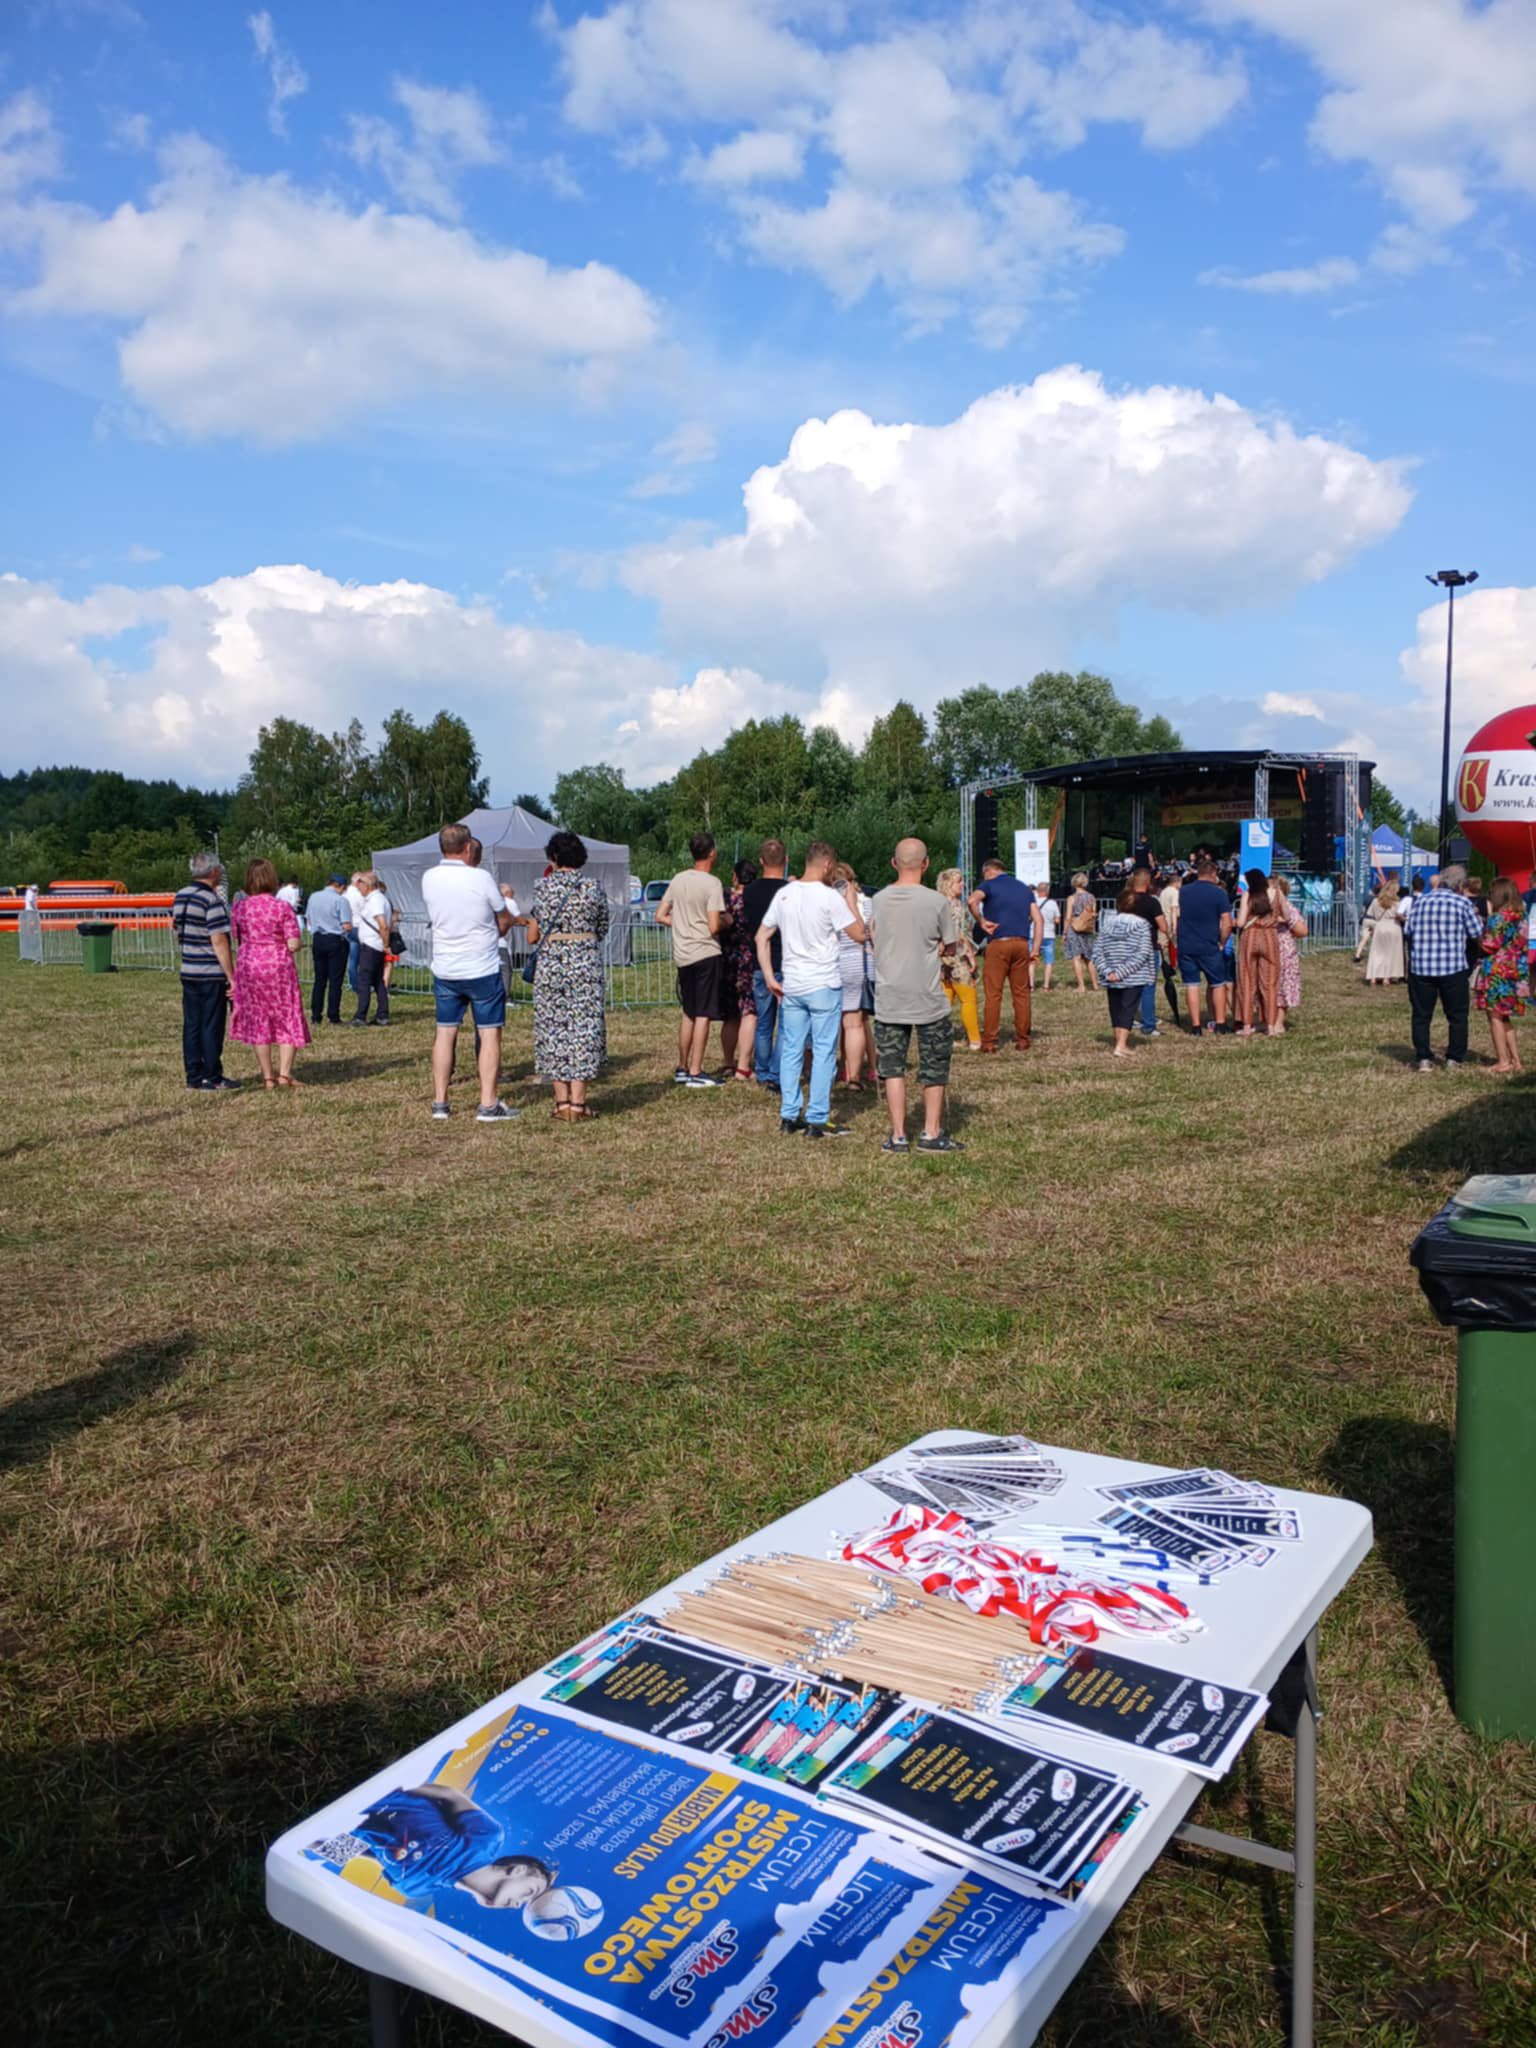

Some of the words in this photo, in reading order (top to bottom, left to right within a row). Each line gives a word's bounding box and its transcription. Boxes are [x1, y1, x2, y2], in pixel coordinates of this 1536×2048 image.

[1493, 797, 1536, 808] www.k
[685, 1688, 728, 1720] LICEUM
[1164, 1699, 1198, 1730] LICEUM
[582, 1761, 658, 1816] lekkoatletyka
[633, 1768, 676, 1798] boccia
[656, 1774, 697, 1801] bilard
[598, 1799, 640, 1828] sztuki
[624, 1802, 664, 1828] piłka
[666, 1784, 725, 1830] NABÓR
[1000, 1786, 1045, 1826] LICEUM
[538, 1817, 589, 1852] szachy
[572, 1824, 610, 1851] walki
[598, 1824, 638, 1854] nożna
[645, 1823, 682, 1847] DO
[610, 1841, 663, 1880] KLAS
[747, 1819, 829, 1892] LICEUM
[576, 1799, 775, 1979] SPORTOWEGO
[607, 1808, 802, 1992] MISTRZOSTWA
[795, 1870, 883, 1947] LICEUM
[927, 1892, 1013, 1971] LICEUM
[812, 1880, 983, 2048] MISTRZOSTW
